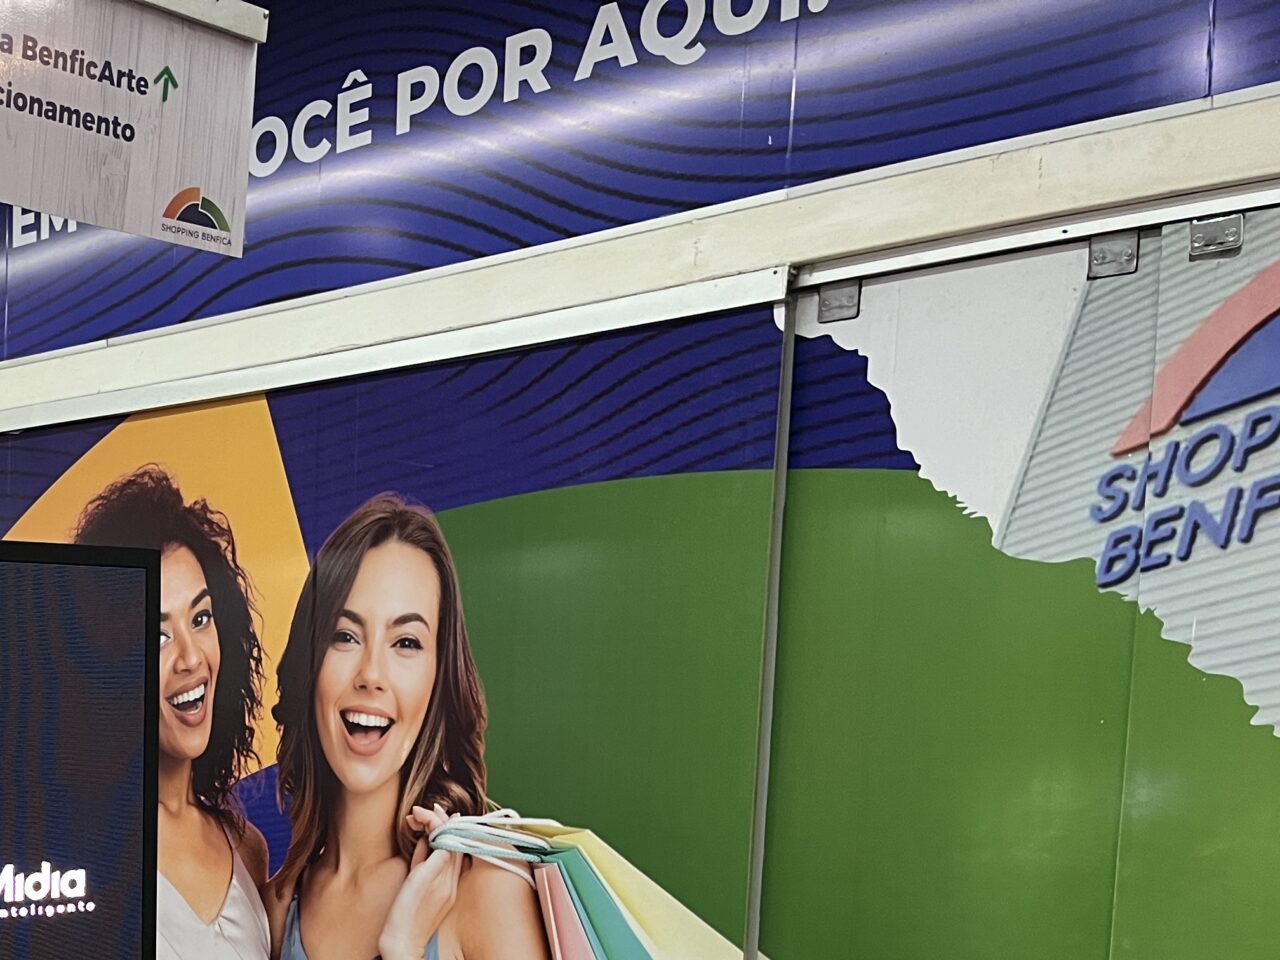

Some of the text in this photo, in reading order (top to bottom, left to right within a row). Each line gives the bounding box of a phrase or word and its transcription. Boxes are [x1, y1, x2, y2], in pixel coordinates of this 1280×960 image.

[21, 33, 150, 96] BenficArte
[396, 28, 554, 136] POR
[161, 223, 232, 246] SHOPPING BENFICA
[1090, 405, 1280, 524] SHOP
[1098, 475, 1280, 589] BENF
